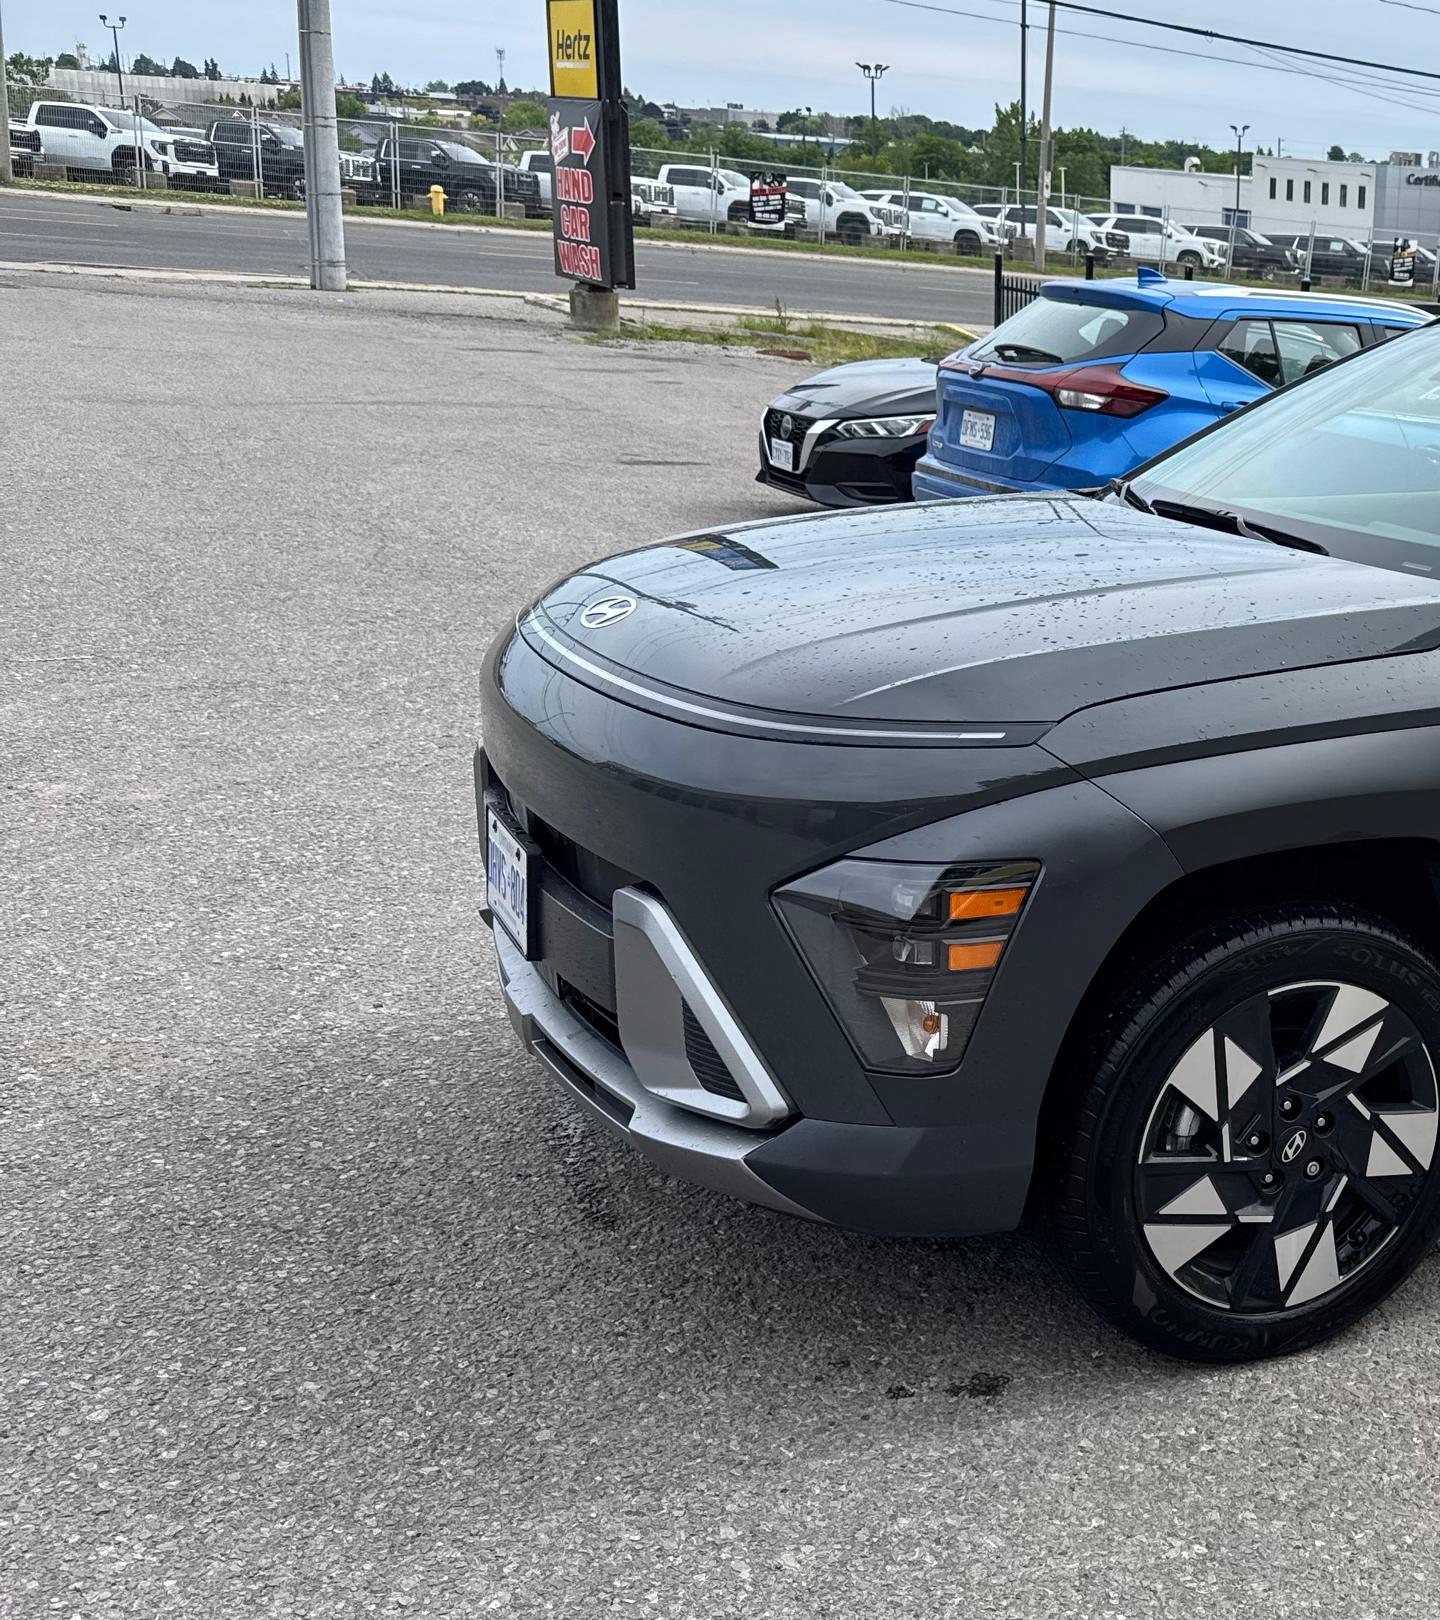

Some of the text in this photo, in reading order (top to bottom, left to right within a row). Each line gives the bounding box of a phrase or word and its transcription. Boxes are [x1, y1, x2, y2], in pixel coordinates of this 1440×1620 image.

[556, 29, 591, 60] Hertz
[556, 166, 593, 204] HAND
[560, 204, 590, 242] CAR
[557, 239, 602, 281] WASH
